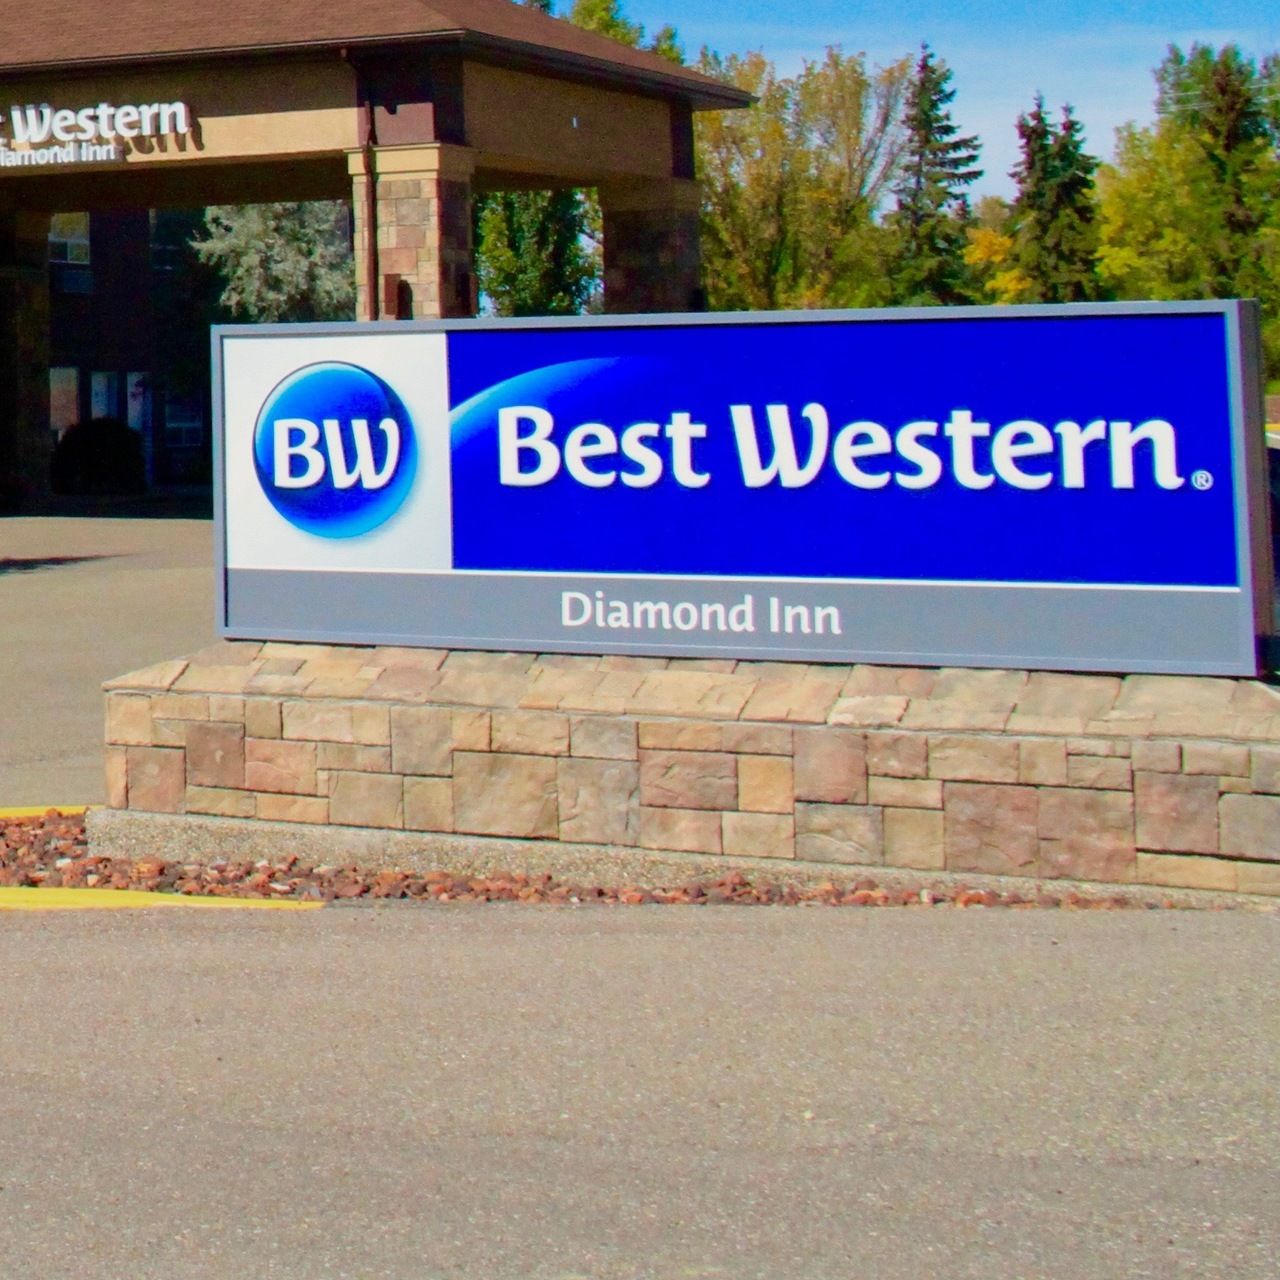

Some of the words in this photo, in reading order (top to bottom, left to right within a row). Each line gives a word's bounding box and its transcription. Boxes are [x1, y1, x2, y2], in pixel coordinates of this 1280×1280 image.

[11, 100, 189, 144] Western
[80, 142, 115, 161] Inn
[272, 417, 400, 490] BW
[497, 405, 710, 490] Best
[560, 590, 756, 634] Diamond
[768, 595, 842, 636] Inn
